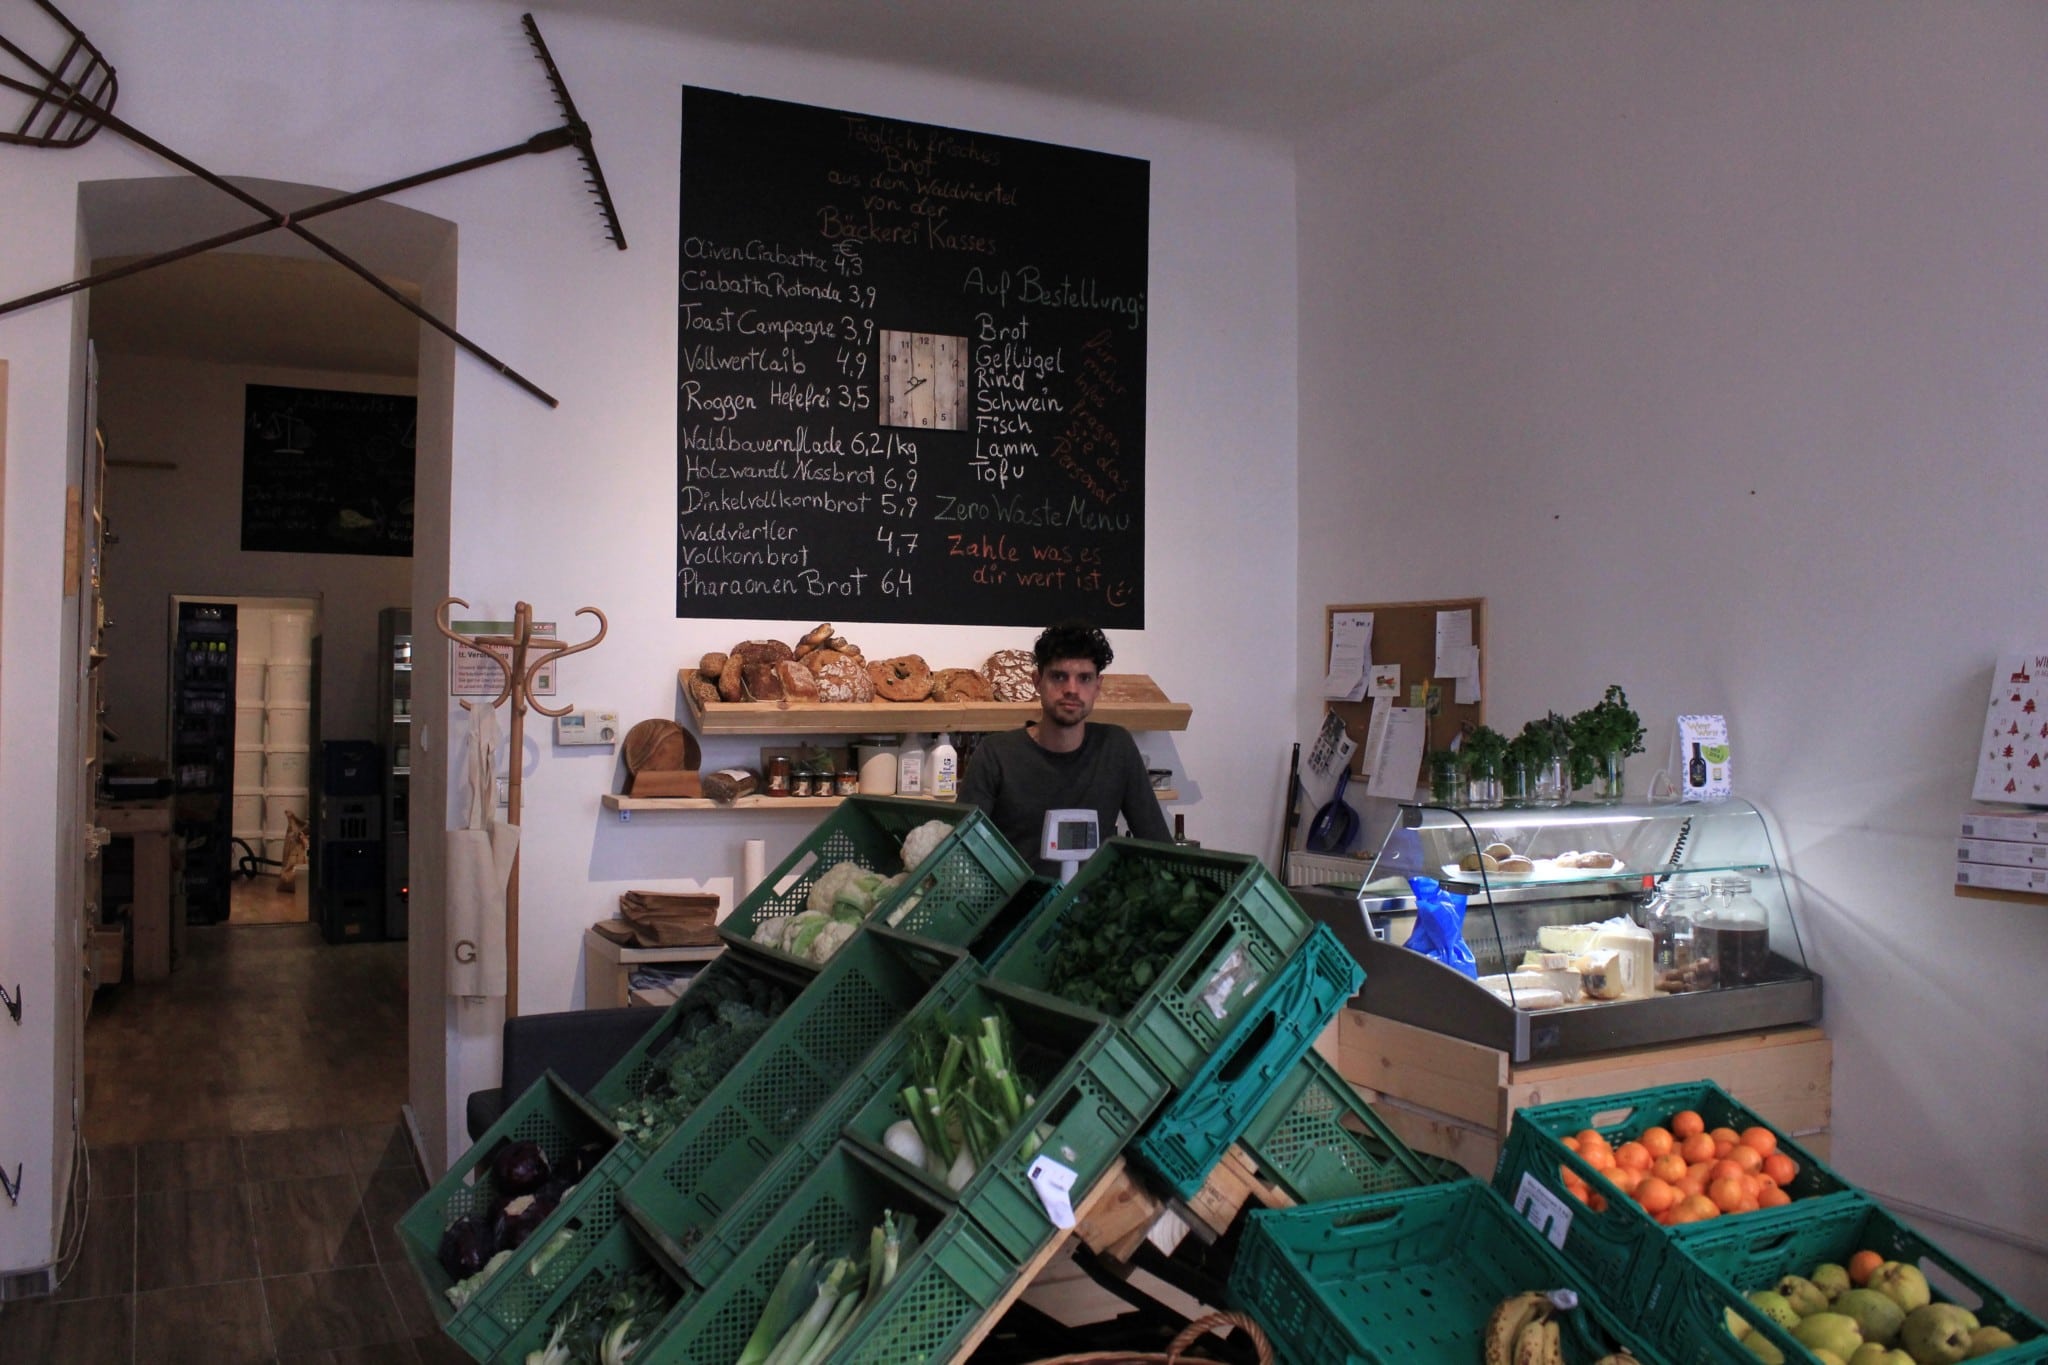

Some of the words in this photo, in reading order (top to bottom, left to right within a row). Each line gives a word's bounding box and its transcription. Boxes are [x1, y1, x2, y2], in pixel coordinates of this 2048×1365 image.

[882, 144, 938, 177] Brot
[828, 170, 860, 188] aus
[870, 172, 908, 192] dem
[914, 178, 1017, 207] Waldviertel
[863, 195, 901, 211] von
[909, 197, 948, 217] der
[816, 205, 920, 245] Bäckerei
[928, 217, 997, 256] Kasses
[835, 254, 863, 277] 4,3
[681, 270, 773, 298] Ciabatta
[767, 272, 842, 303] Rotonda
[848, 285, 876, 309] 3,9
[963, 266, 1011, 309] Auf
[1016, 265, 1145, 331] Bestellung:
[680, 302, 735, 332] Toast
[737, 309, 837, 344] Campagne
[841, 316, 875, 346] 3,9
[974, 312, 1030, 341] Brot
[920, 337, 929, 345] 12
[975, 343, 1065, 379] Geflügel
[974, 367, 1025, 392] Rind
[680, 380, 756, 421] Roggen
[770, 380, 831, 411] Hefefrei
[838, 385, 870, 412] 3,5
[976, 387, 1065, 413] Schwein
[976, 413, 1033, 435] Fisch
[682, 424, 845, 463] Waldbauernflade
[975, 437, 1040, 460] Lamm
[793, 459, 876, 485] Nussbrot
[884, 468, 918, 492] 6,9
[968, 458, 1025, 490] Tofu
[681, 485, 872, 516] Dinkelvollkornbrot
[881, 494, 918, 519] 5,9
[934, 494, 989, 522] Zero
[992, 494, 1063, 528] Waste
[1066, 495, 1129, 531] Menu
[680, 520, 798, 541] Waldviertler
[877, 526, 919, 557] 4,7
[947, 533, 1019, 561] Zahle
[1032, 543, 1072, 563] was
[1080, 545, 1101, 565] es
[678, 567, 798, 599] Pharaonen
[798, 566, 868, 597] Brot
[881, 568, 913, 598] 6,4
[972, 563, 1007, 585] dir
[1016, 567, 1066, 590] wert
[1075, 565, 1102, 591] ist
[455, 940, 476, 964] G
